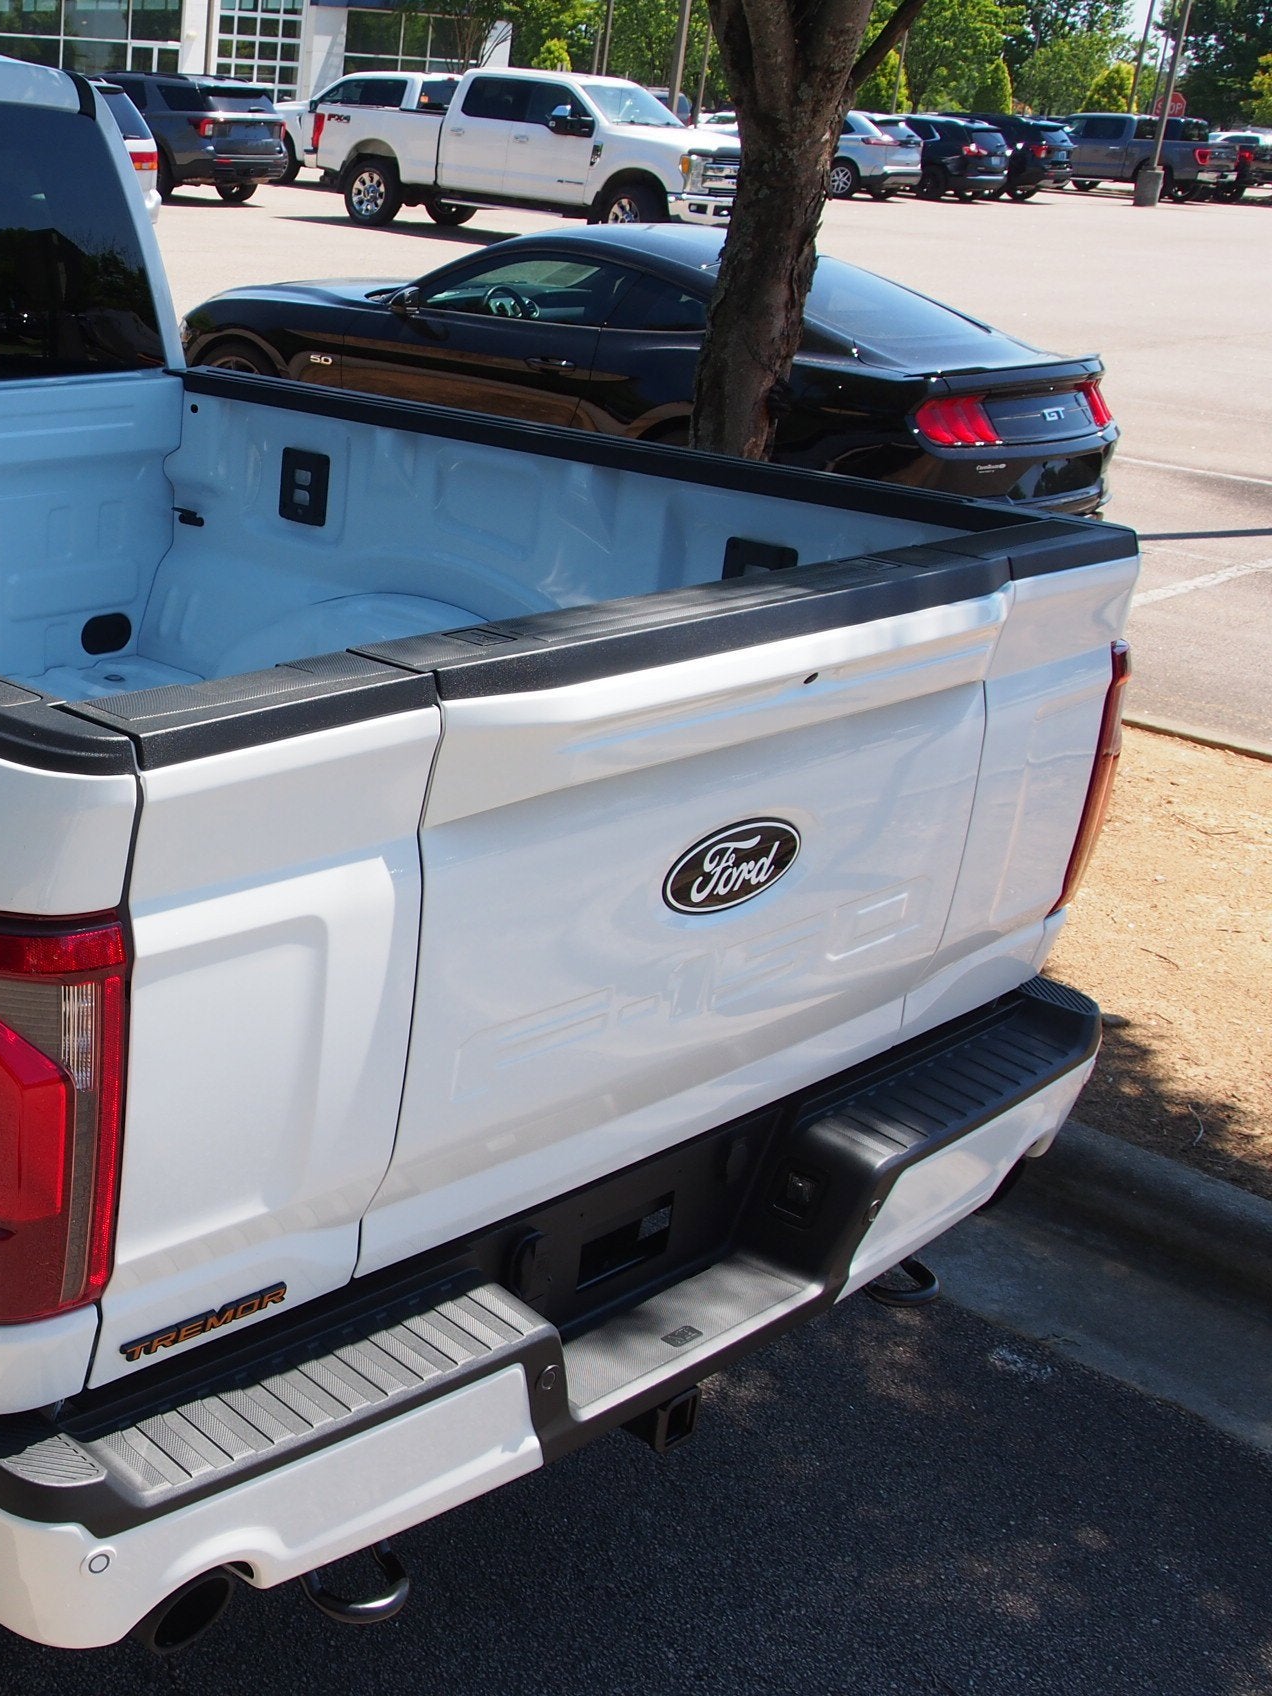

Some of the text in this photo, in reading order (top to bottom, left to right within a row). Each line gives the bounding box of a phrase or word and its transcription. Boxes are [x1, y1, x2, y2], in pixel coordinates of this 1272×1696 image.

[1156, 102, 1183, 114] SOP
[1043, 407, 1065, 421] GT
[690, 834, 781, 903] Ford
[119, 1281, 288, 1362] TREMOR
